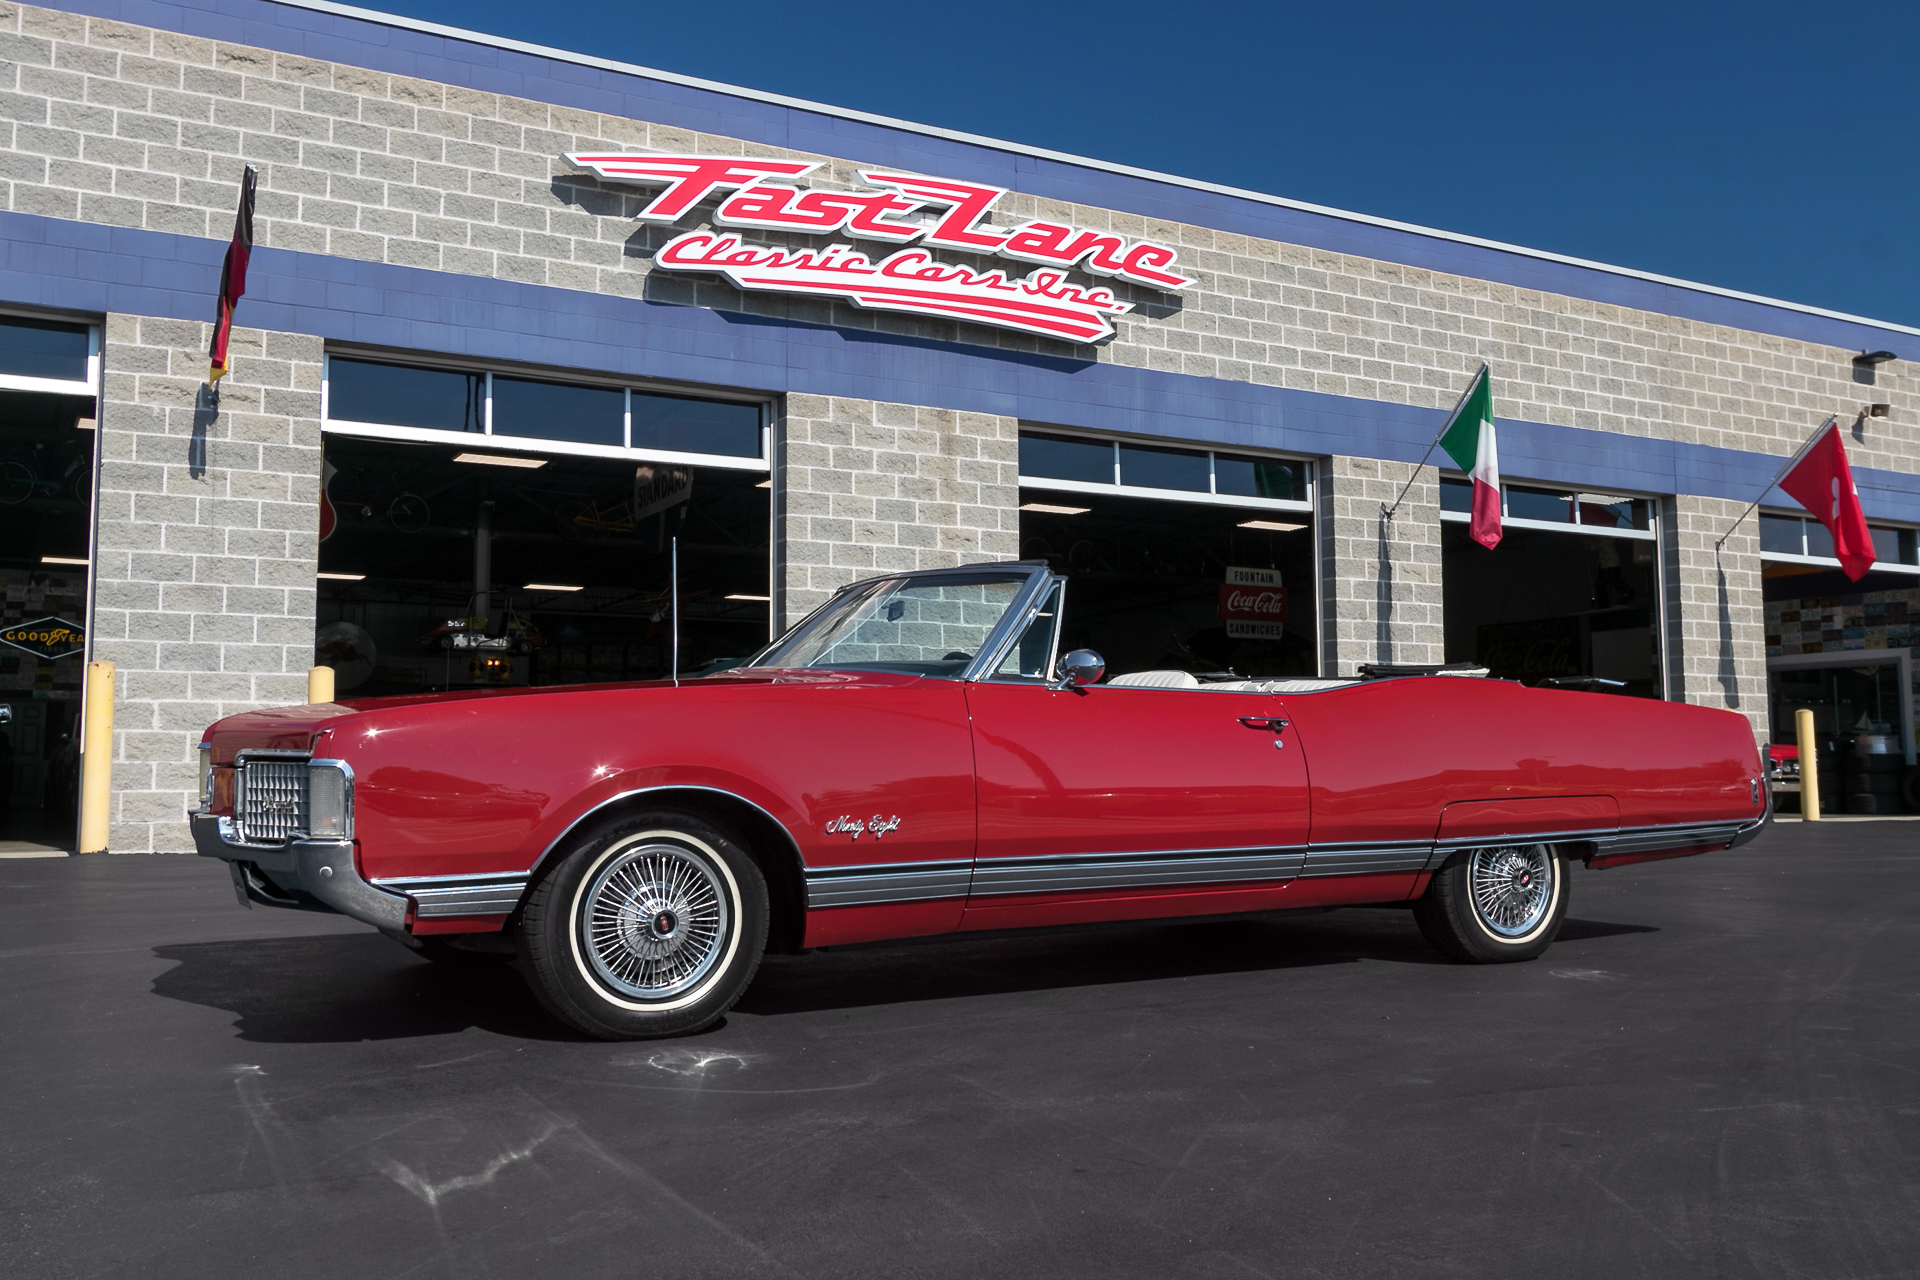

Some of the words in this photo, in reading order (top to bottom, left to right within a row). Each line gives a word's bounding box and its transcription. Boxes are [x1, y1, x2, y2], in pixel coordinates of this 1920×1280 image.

[568, 154, 922, 239] Fast
[860, 173, 1190, 288] Lane
[660, 236, 877, 275] Classic
[881, 253, 1017, 292] Cars
[1021, 272, 1126, 311] Inc.
[638, 467, 689, 509] STANDARD
[1234, 570, 1274, 584] FOUNTAIN
[1227, 590, 1283, 613] Coca-Cola
[5, 630, 85, 643] GOODYEA
[1229, 623, 1281, 636] SANDWICHES
[868, 814, 901, 838] Eight
